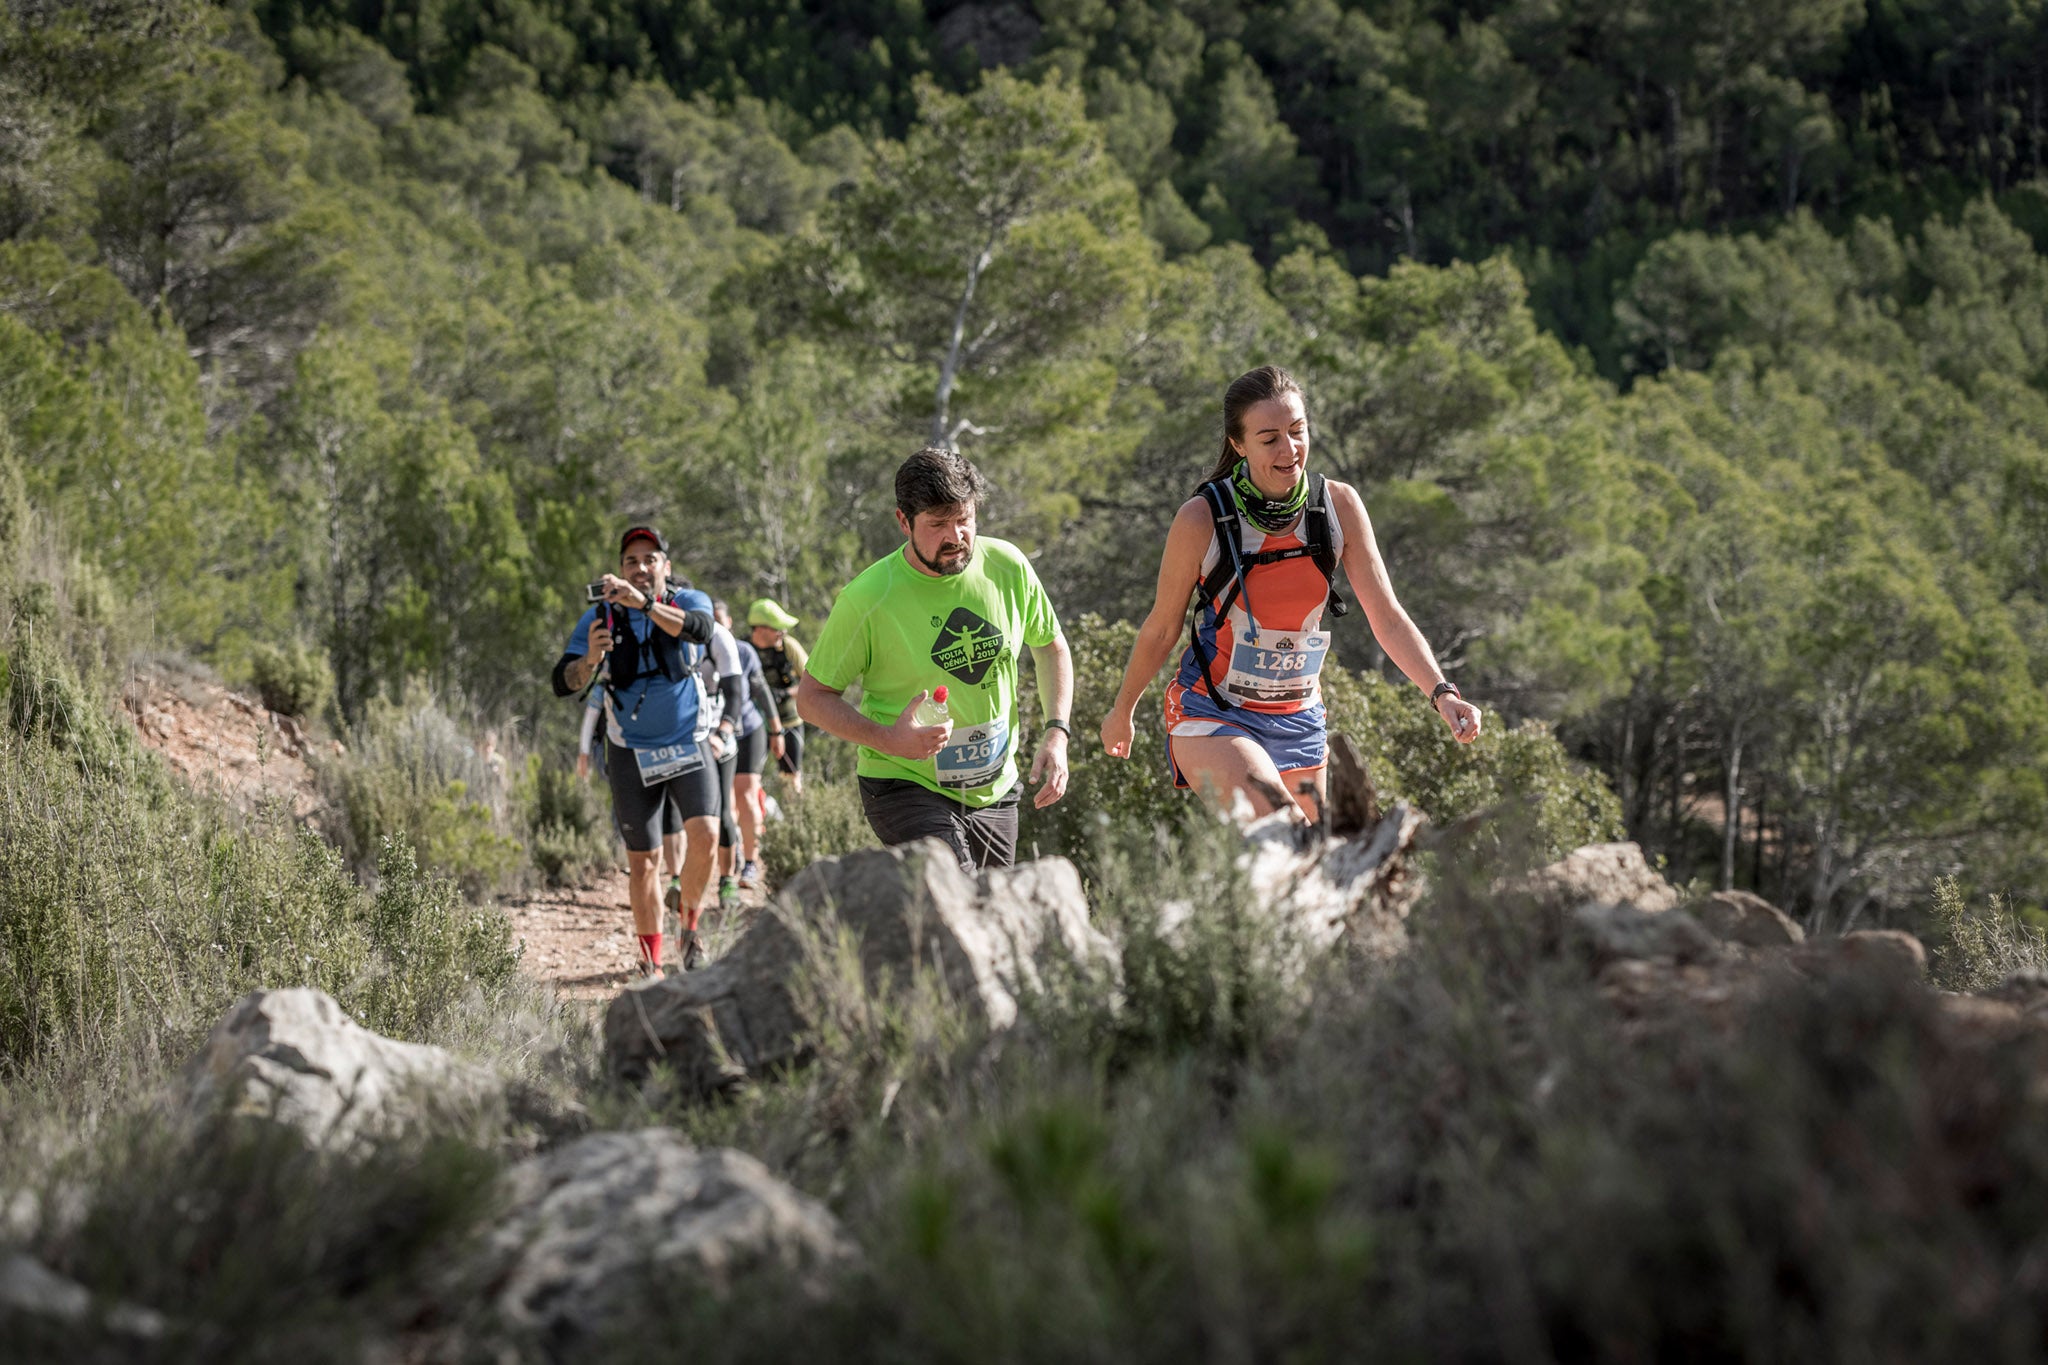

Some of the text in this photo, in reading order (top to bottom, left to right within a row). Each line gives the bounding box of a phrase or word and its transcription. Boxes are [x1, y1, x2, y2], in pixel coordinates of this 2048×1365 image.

[938, 638, 999, 662] VOLTA A PEU
[976, 648, 996, 660] 2018
[1254, 651, 1307, 671] 1268
[955, 737, 999, 763] 1267
